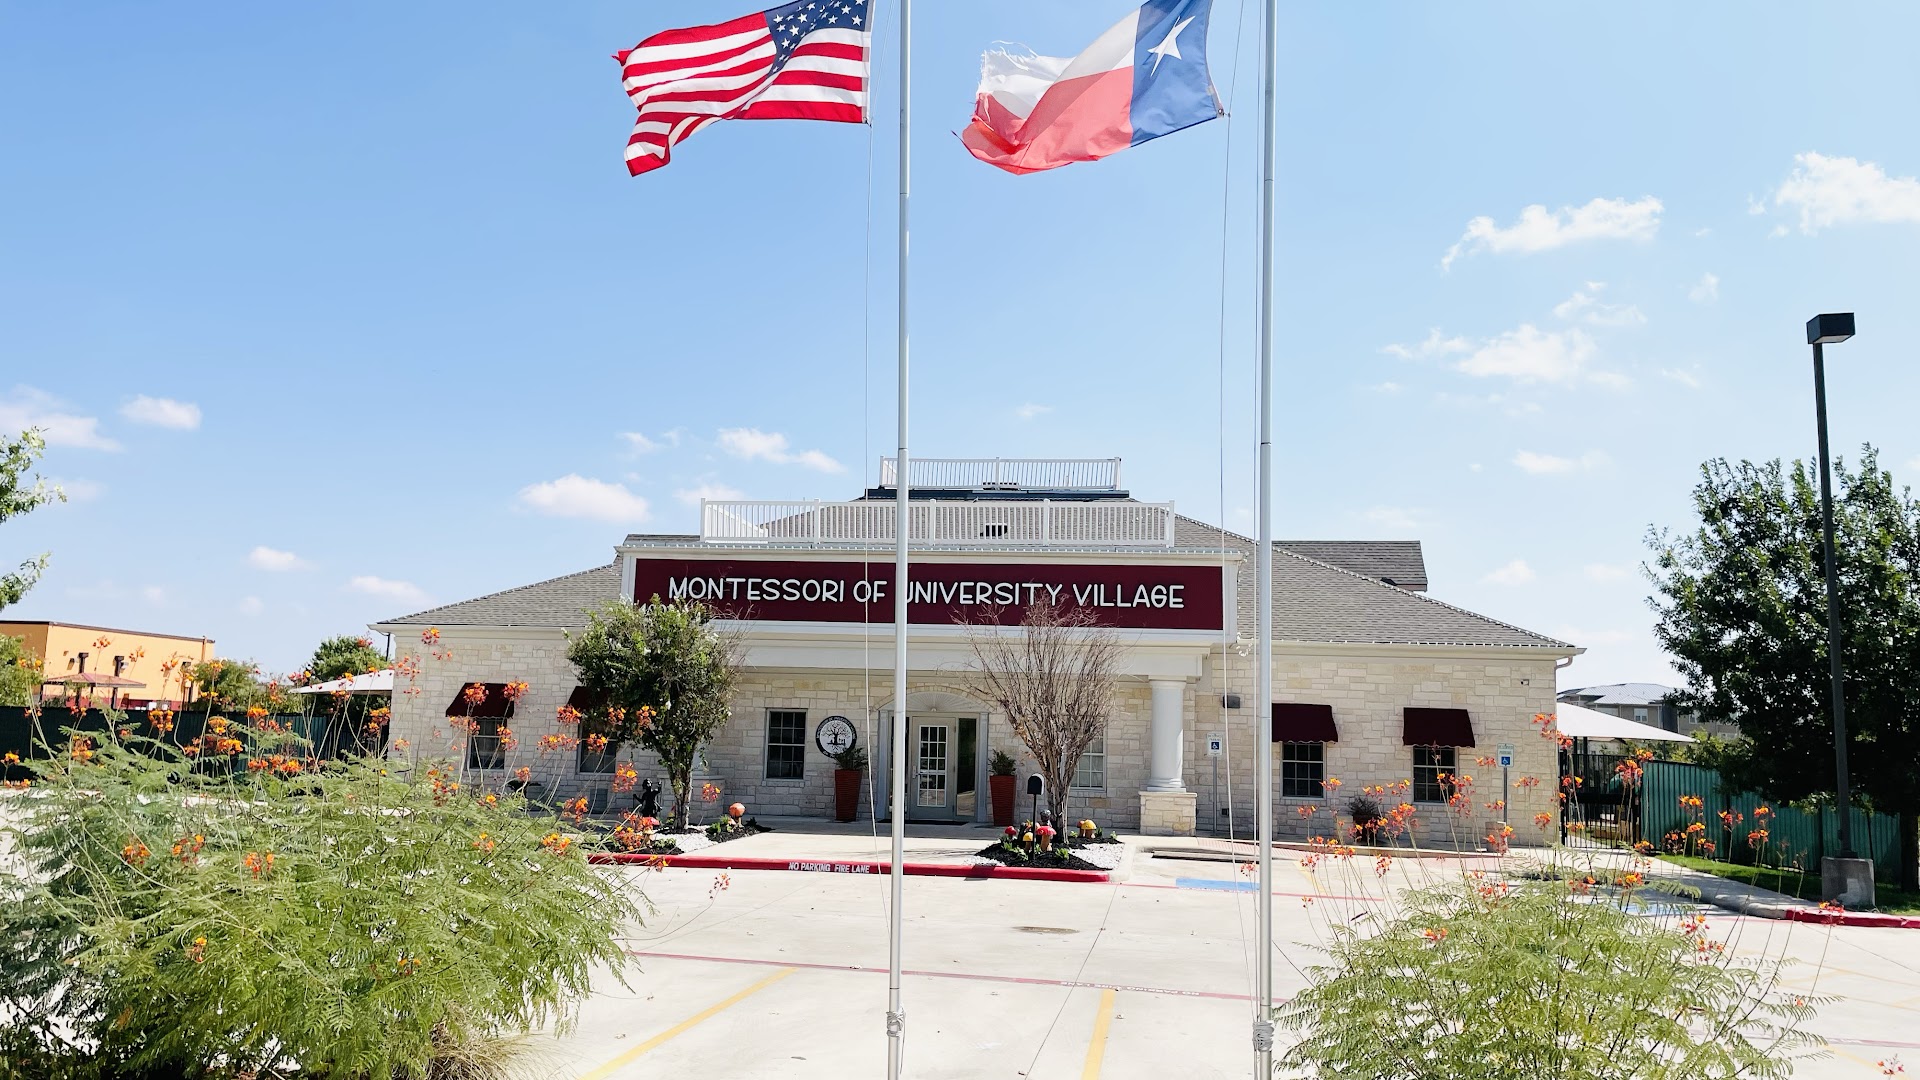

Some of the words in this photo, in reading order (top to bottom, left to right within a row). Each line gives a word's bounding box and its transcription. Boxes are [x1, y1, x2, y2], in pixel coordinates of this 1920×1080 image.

[668, 576, 844, 602] MONTESSORI
[853, 580, 888, 603] OF
[1072, 583, 1185, 609] VILLAGE
[788, 861, 800, 870] NO
[801, 862, 831, 872] PARKING
[834, 864, 850, 873] FIRE
[851, 864, 870, 873] LANE
